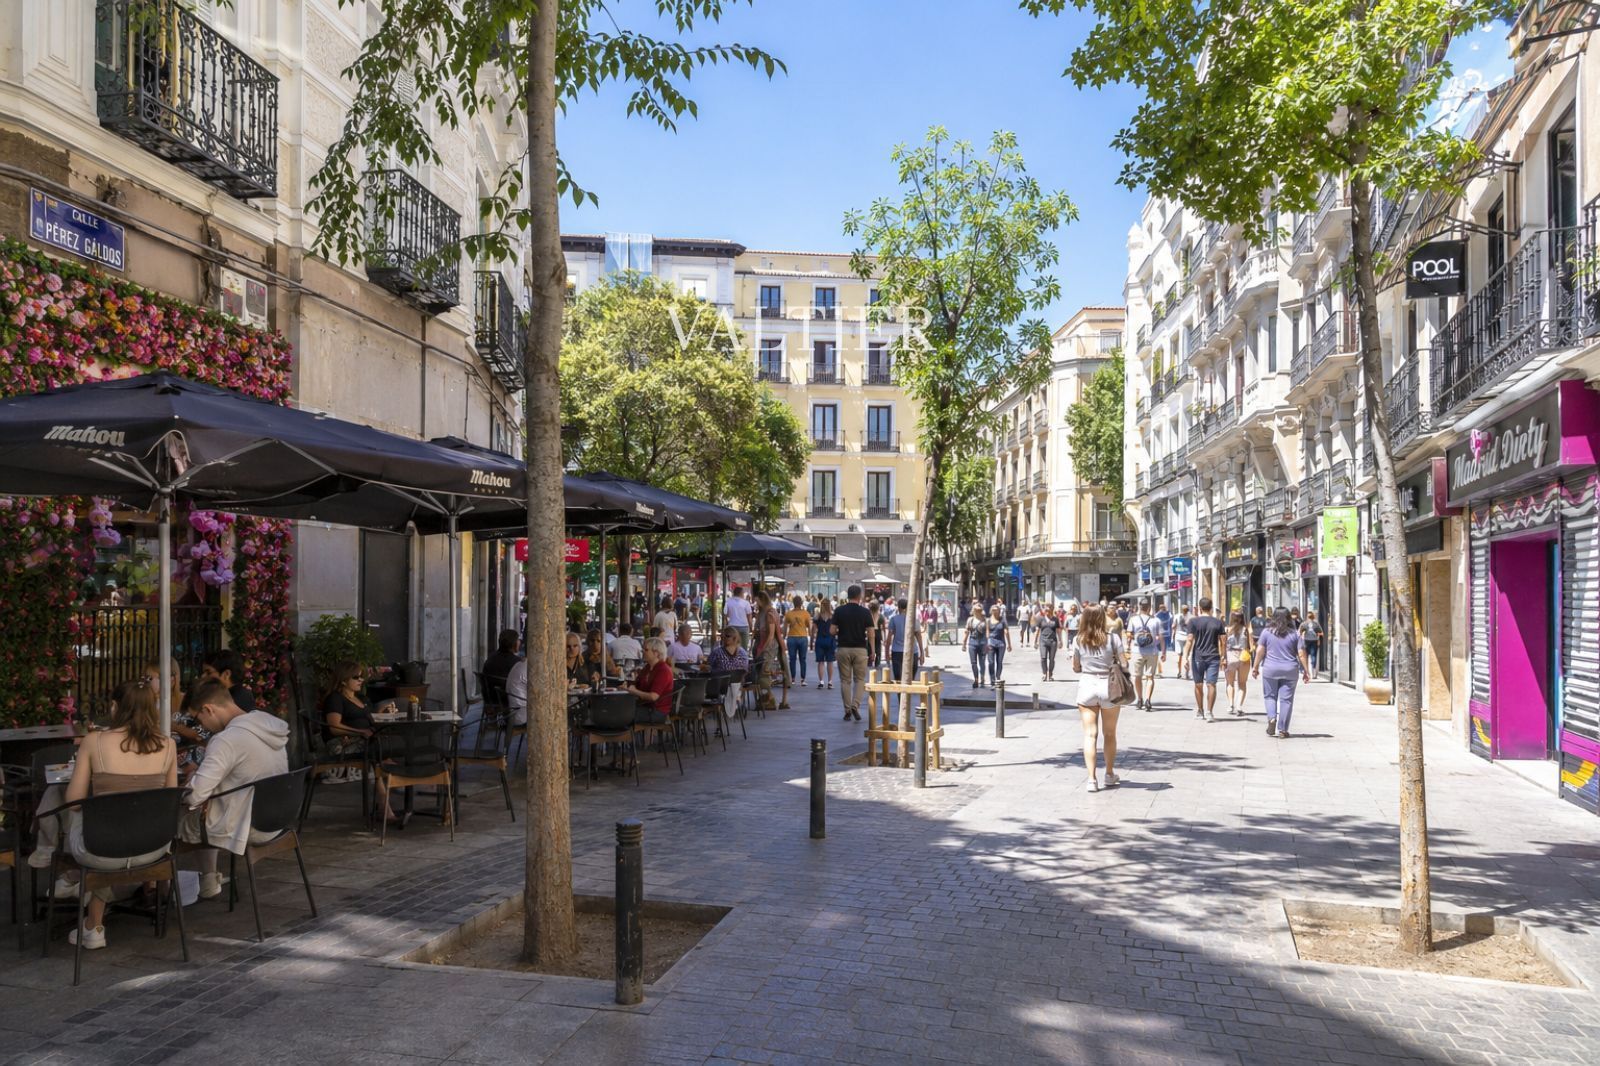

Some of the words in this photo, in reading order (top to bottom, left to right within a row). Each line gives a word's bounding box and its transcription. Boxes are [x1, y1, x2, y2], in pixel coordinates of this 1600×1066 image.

[72, 209, 100, 230] CALLE
[45, 222, 80, 251] PÉREZ
[84, 237, 122, 266] GÁLDOS
[1412, 258, 1460, 277] POOL
[43, 426, 126, 447] Mahou
[470, 469, 511, 488] Mahou
